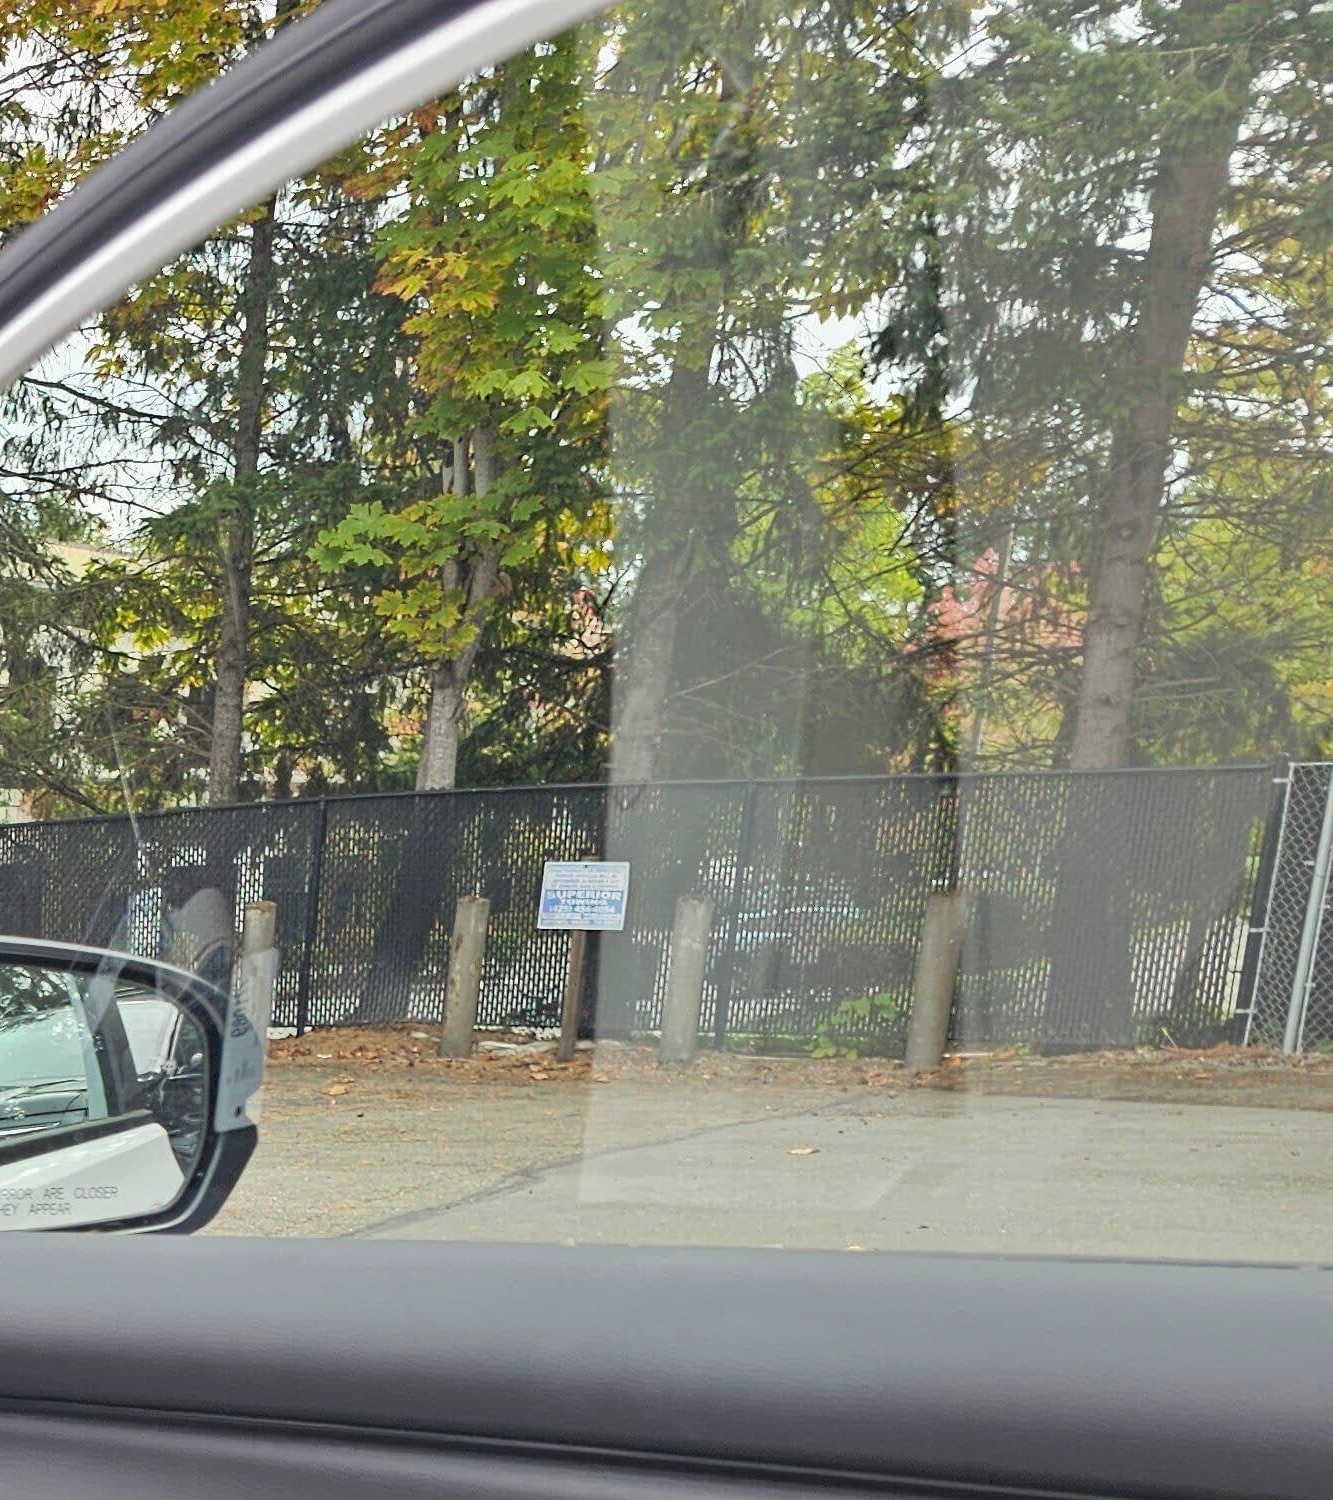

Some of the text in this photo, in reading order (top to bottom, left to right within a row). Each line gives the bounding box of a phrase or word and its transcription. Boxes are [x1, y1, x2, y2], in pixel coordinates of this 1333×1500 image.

[546, 890, 622, 900] SUPERIOR
[43, 1187, 65, 1200] ARE
[74, 1187, 118, 1199] CLOSER
[28, 1203, 72, 1215] APPEAR
